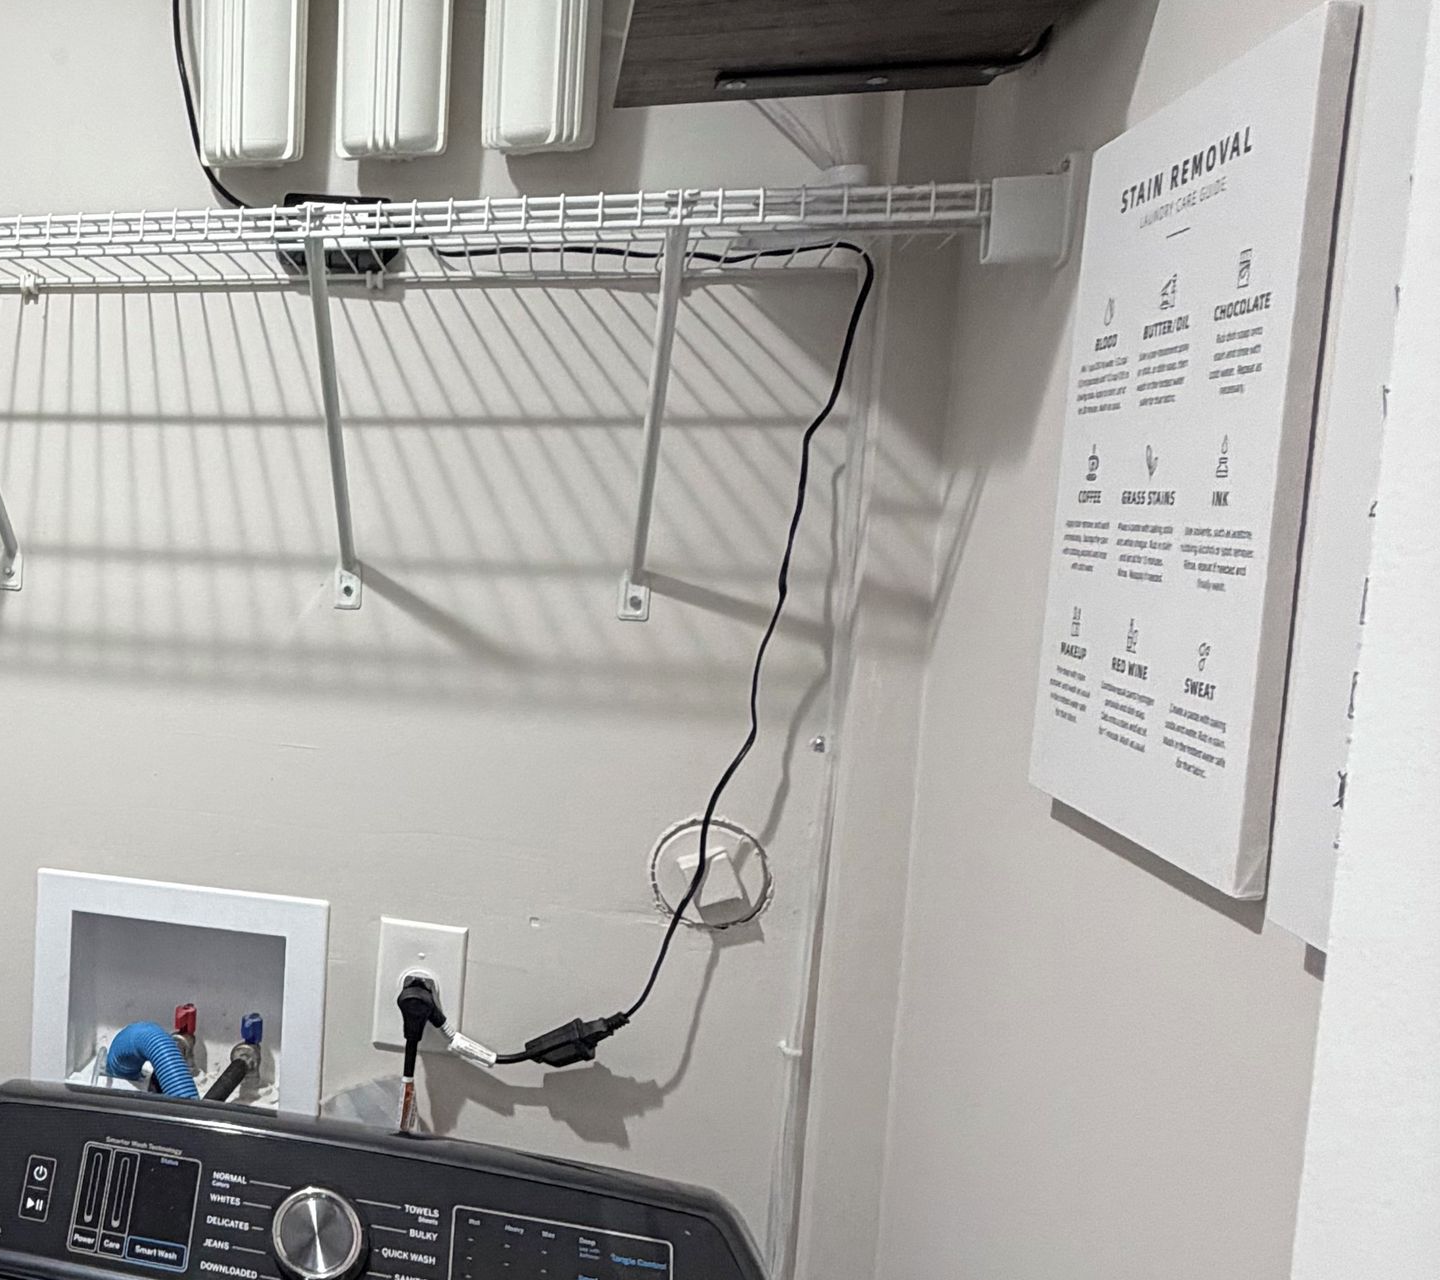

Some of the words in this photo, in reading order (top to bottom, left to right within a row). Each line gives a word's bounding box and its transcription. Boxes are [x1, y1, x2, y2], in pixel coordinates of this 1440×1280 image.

[1120, 172, 1164, 214] STAIN
[1170, 126, 1253, 191] REMOVAL
[1175, 190, 1198, 213] CARE
[1214, 291, 1272, 322] CHOCOLATE
[1142, 314, 1190, 340] BUTTER/OIL
[1094, 333, 1118, 352] BLOOD
[1078, 490, 1102, 504] COFFEE
[1120, 490, 1147, 505] GRASS
[1147, 490, 1176, 506] STAINS
[1211, 490, 1230, 507] INK
[1111, 656, 1127, 674] RED
[1127, 661, 1149, 681] WINE
[1183, 677, 1217, 701] SWEAT
[213, 1171, 248, 1185] NORMAL
[210, 1193, 241, 1206] WHITES
[404, 1204, 440, 1218] TOWELS
[206, 1215, 250, 1231] DELICATES
[73, 1233, 96, 1245] Power
[409, 1228, 439, 1241] BULKY
[103, 1238, 120, 1250] Care
[134, 1244, 157, 1256] Smart
[157, 1248, 178, 1261] Wash
[203, 1238, 230, 1251] JEANS
[381, 1246, 409, 1261] QUICK
[409, 1252, 436, 1266] WASH
[200, 1261, 258, 1280] DOWNLOADED
